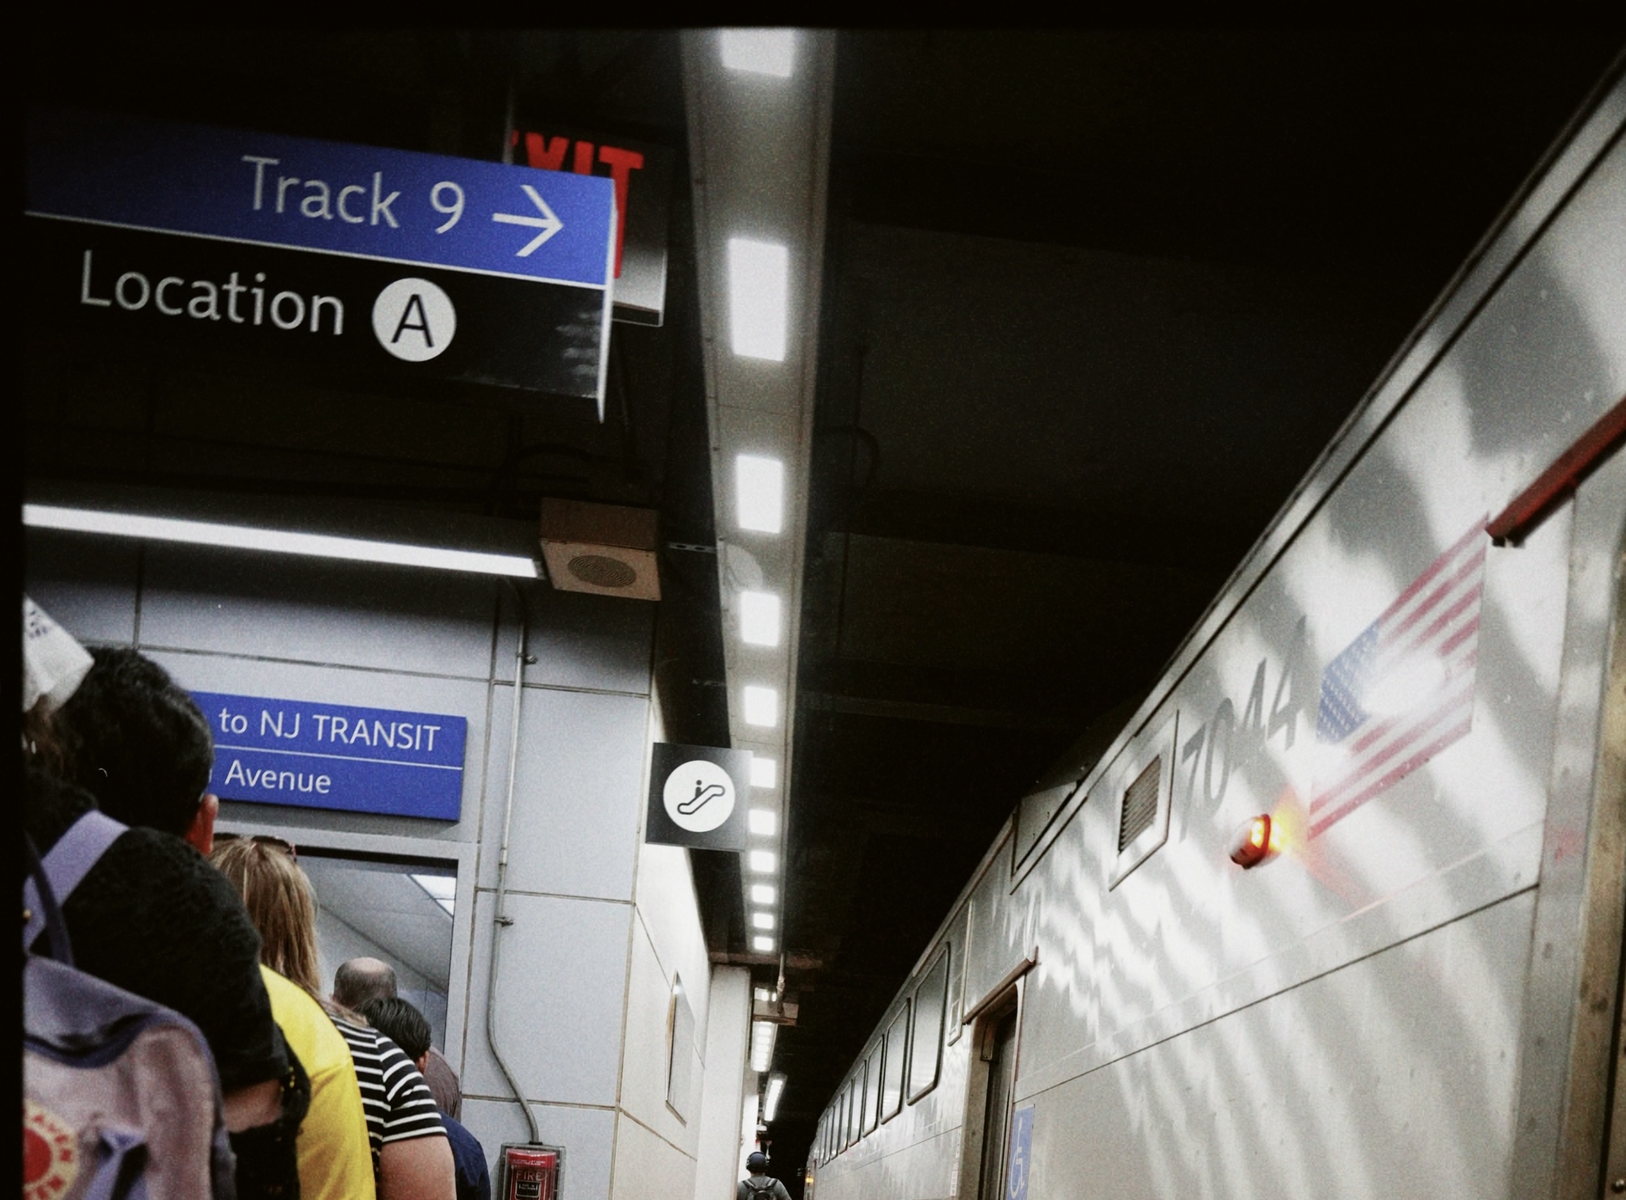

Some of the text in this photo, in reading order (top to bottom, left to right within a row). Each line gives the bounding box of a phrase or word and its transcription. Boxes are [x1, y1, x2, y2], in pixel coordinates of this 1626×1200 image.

[242, 155, 400, 229] Track
[430, 181, 466, 234] 9
[81, 249, 435, 348] Location A
[219, 707, 441, 752] to NJ TRANSIT
[224, 759, 332, 794] Avenue
[516, 1169, 545, 1182] FIRE
